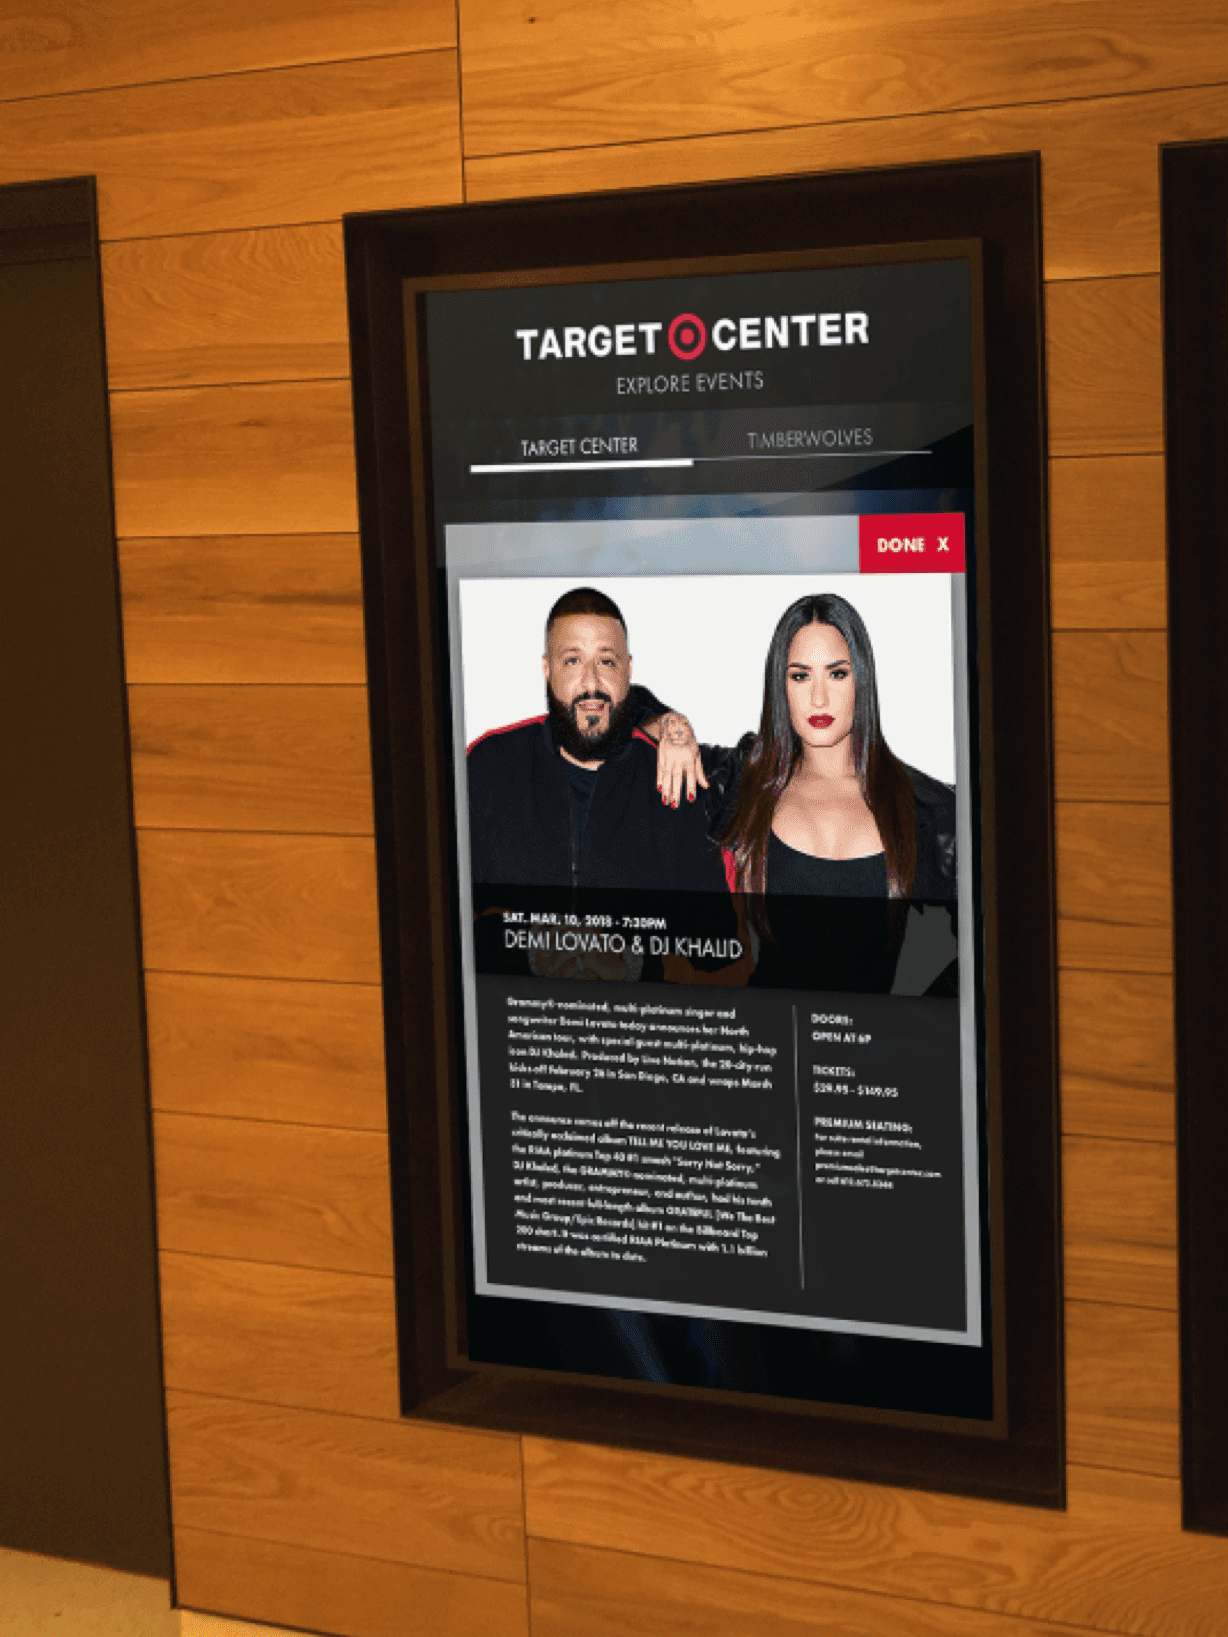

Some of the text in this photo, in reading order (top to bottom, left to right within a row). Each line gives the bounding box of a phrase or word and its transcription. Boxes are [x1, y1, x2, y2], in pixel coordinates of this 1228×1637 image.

[516, 312, 868, 360] TARGET CENTER
[618, 371, 763, 394] EXPLORE EVENTS
[521, 437, 637, 456] TARGET CENTER
[747, 428, 873, 449] TIMBERWOLVES
[877, 538, 949, 552] DONE X
[503, 911, 527, 922] SAT.
[530, 913, 561, 925] MAR.
[565, 915, 581, 927] 10,
[505, 929, 550, 950] DEMI
[556, 932, 625, 953] LOVATO
[631, 936, 643, 955] &
[650, 936, 669, 955] DJ
[811, 1014, 853, 1025] DOORS:
[812, 1031, 841, 1042] OPEN
[843, 1033, 855, 1042] AT
[629, 1136, 647, 1146] TELL
[666, 1139, 687, 1150] YOU
